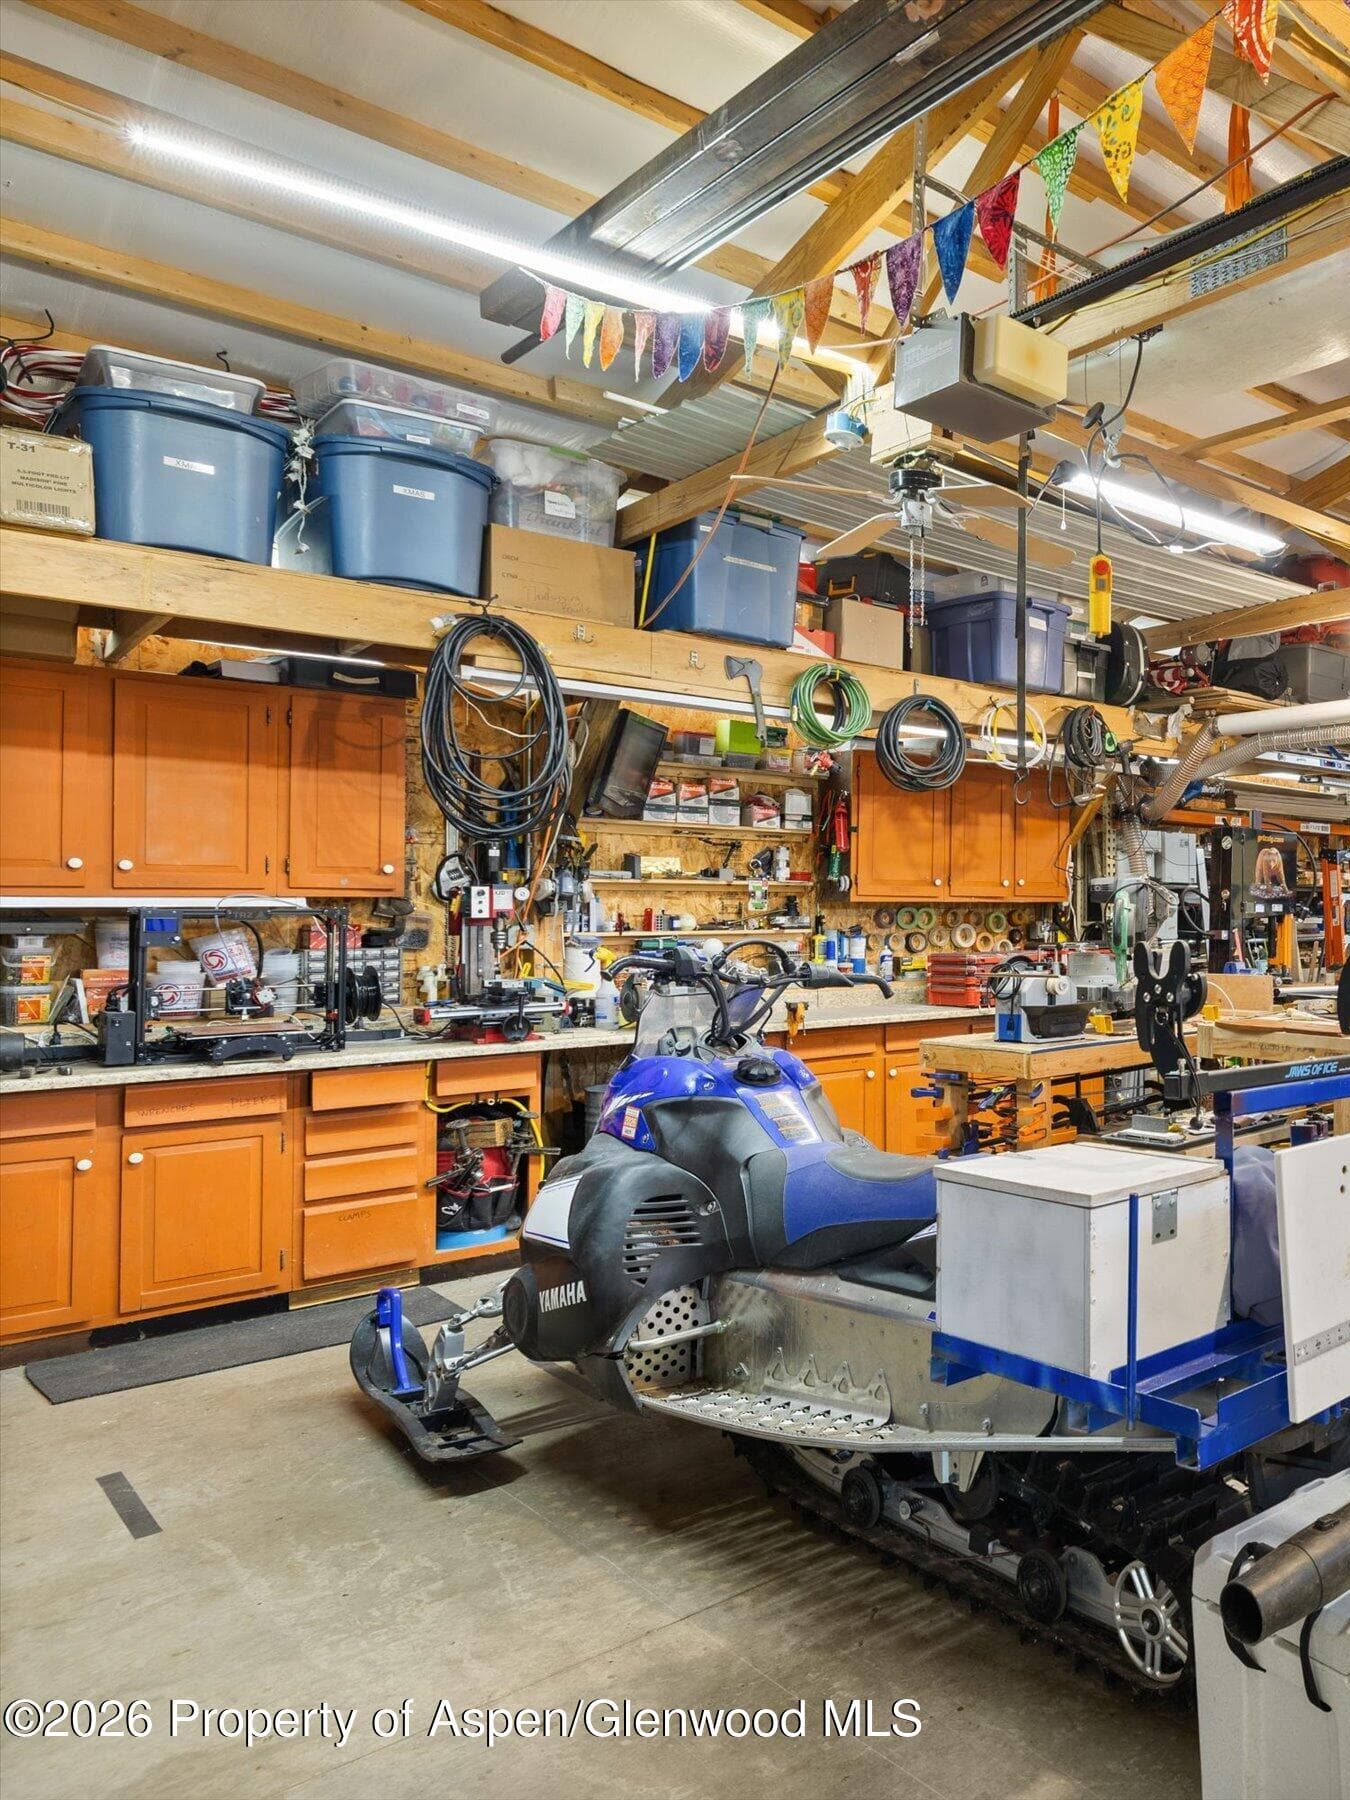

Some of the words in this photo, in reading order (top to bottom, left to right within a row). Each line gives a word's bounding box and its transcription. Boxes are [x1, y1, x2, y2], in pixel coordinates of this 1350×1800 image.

[7, 441, 36, 453] T-31
[11, 480, 53, 491] MULTICOLOR
[54, 486, 77, 495] LIGHTS
[1285, 1064, 1311, 1079] JAWS
[1311, 1063, 1324, 1075] OF
[1323, 1061, 1339, 1074] ICE
[539, 1280, 588, 1313] YAMAHA
